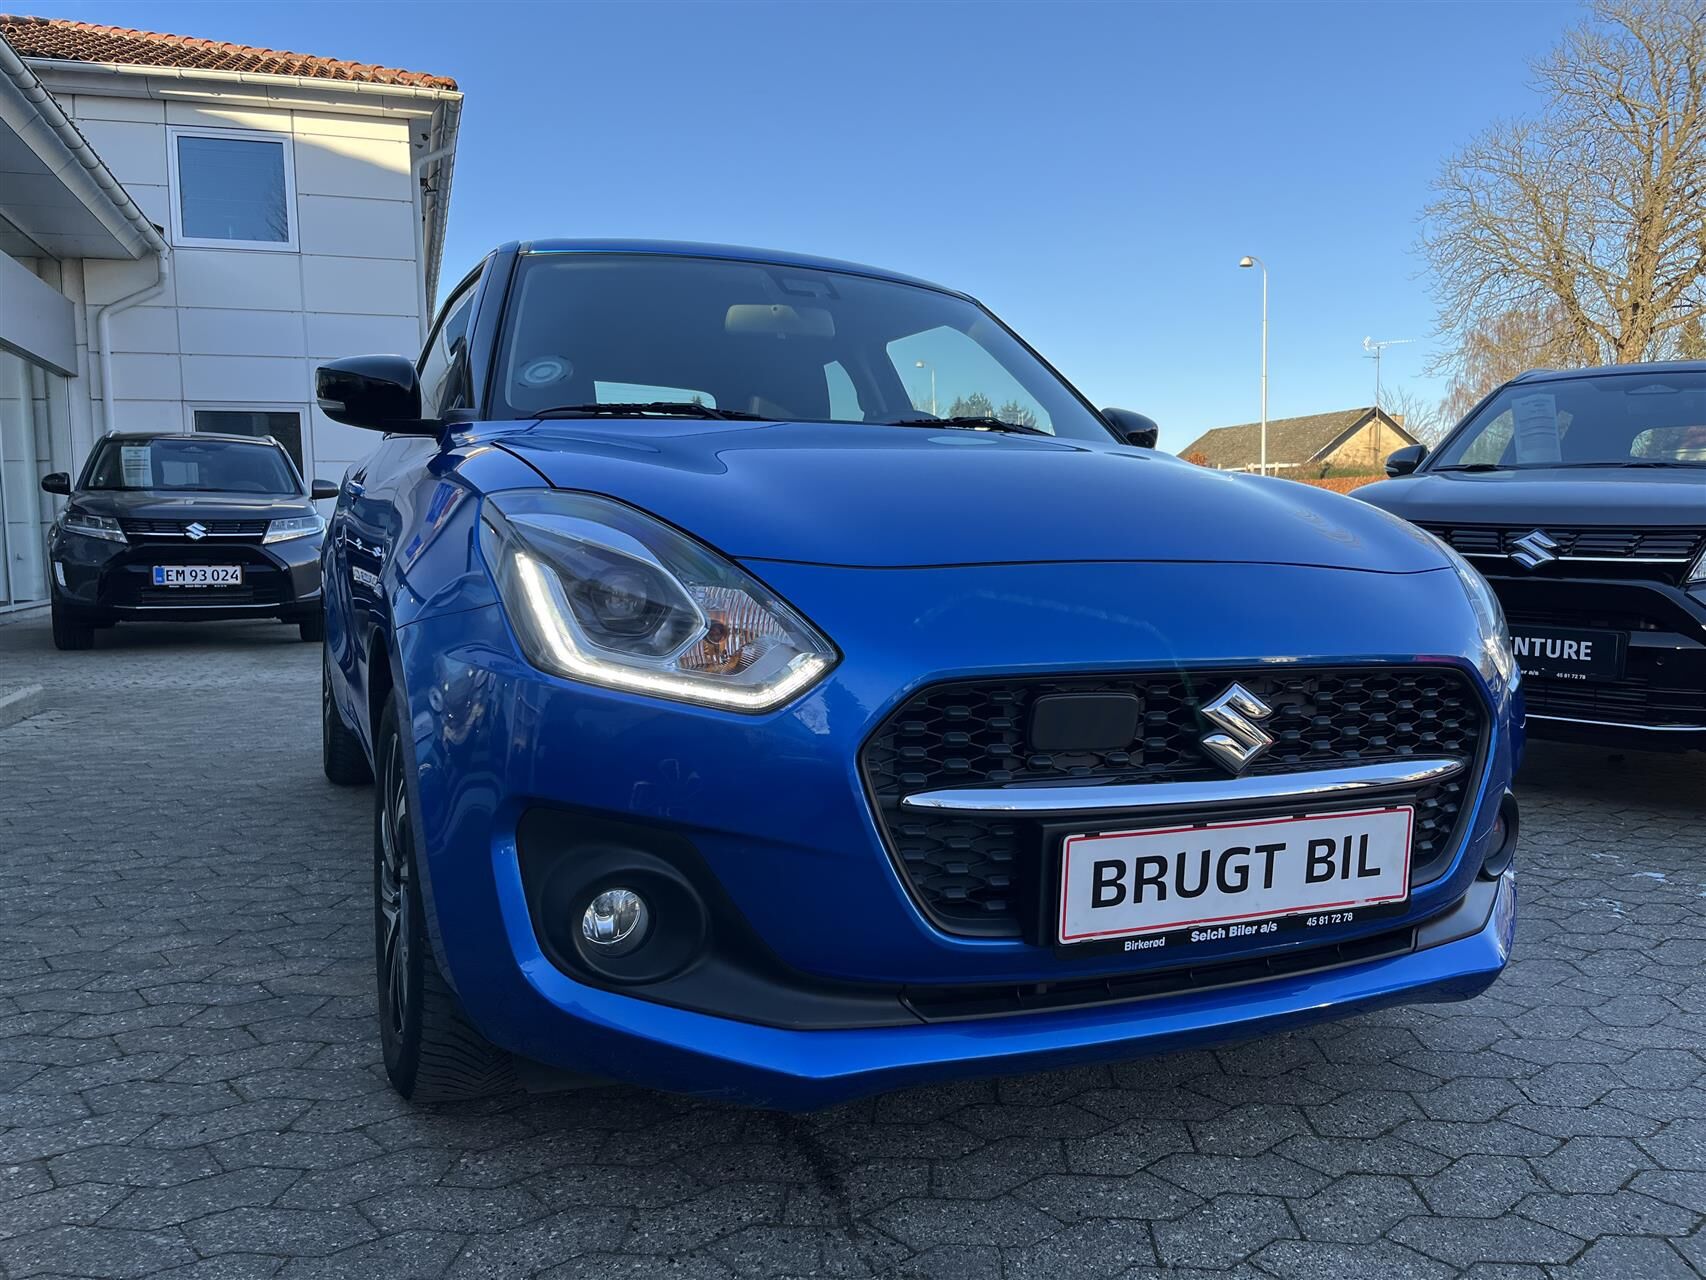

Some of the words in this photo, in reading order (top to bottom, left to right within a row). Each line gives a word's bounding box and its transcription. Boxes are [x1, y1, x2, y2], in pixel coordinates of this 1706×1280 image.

[166, 569, 186, 582] EM
[189, 569, 208, 582] 93
[211, 569, 239, 582] 024
[1510, 636, 1593, 661] NTURE
[1091, 842, 1287, 909] BRUGT
[1304, 833, 1382, 884] BIL
[1306, 916, 1318, 927] 45
[1319, 915, 1329, 925] 81
[1331, 912, 1342, 924] 72
[1343, 911, 1353, 922] 78
[1190, 926, 1226, 943] Selch
[1228, 924, 1258, 938] Biler
[1260, 920, 1278, 935] a/s
[1124, 936, 1166, 952] Birkerød
